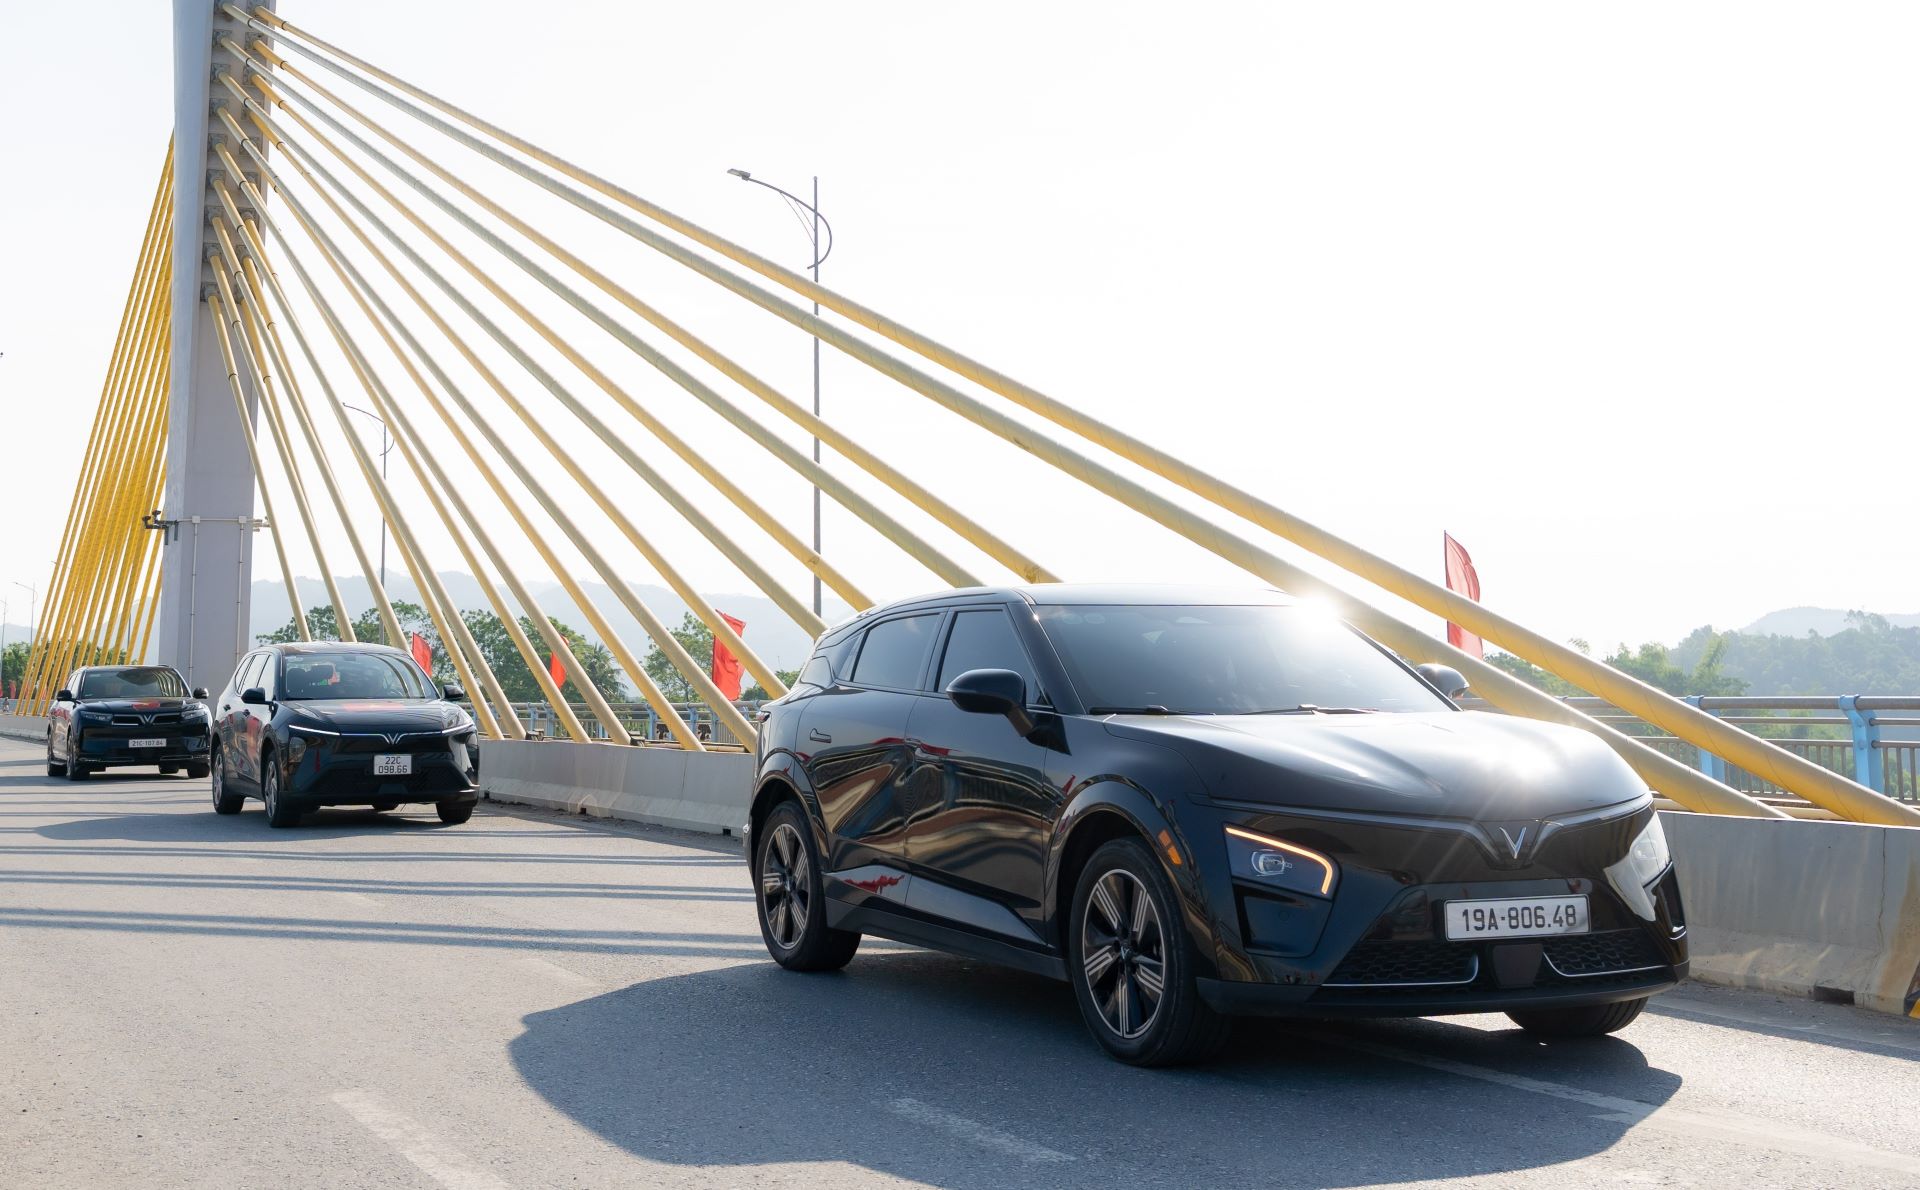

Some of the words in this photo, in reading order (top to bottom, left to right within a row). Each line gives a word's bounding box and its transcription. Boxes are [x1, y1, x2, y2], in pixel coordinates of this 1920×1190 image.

[385, 756, 401, 765] 22C
[378, 765, 408, 774] 098.66
[1462, 905, 1577, 932] 19A-806.48
